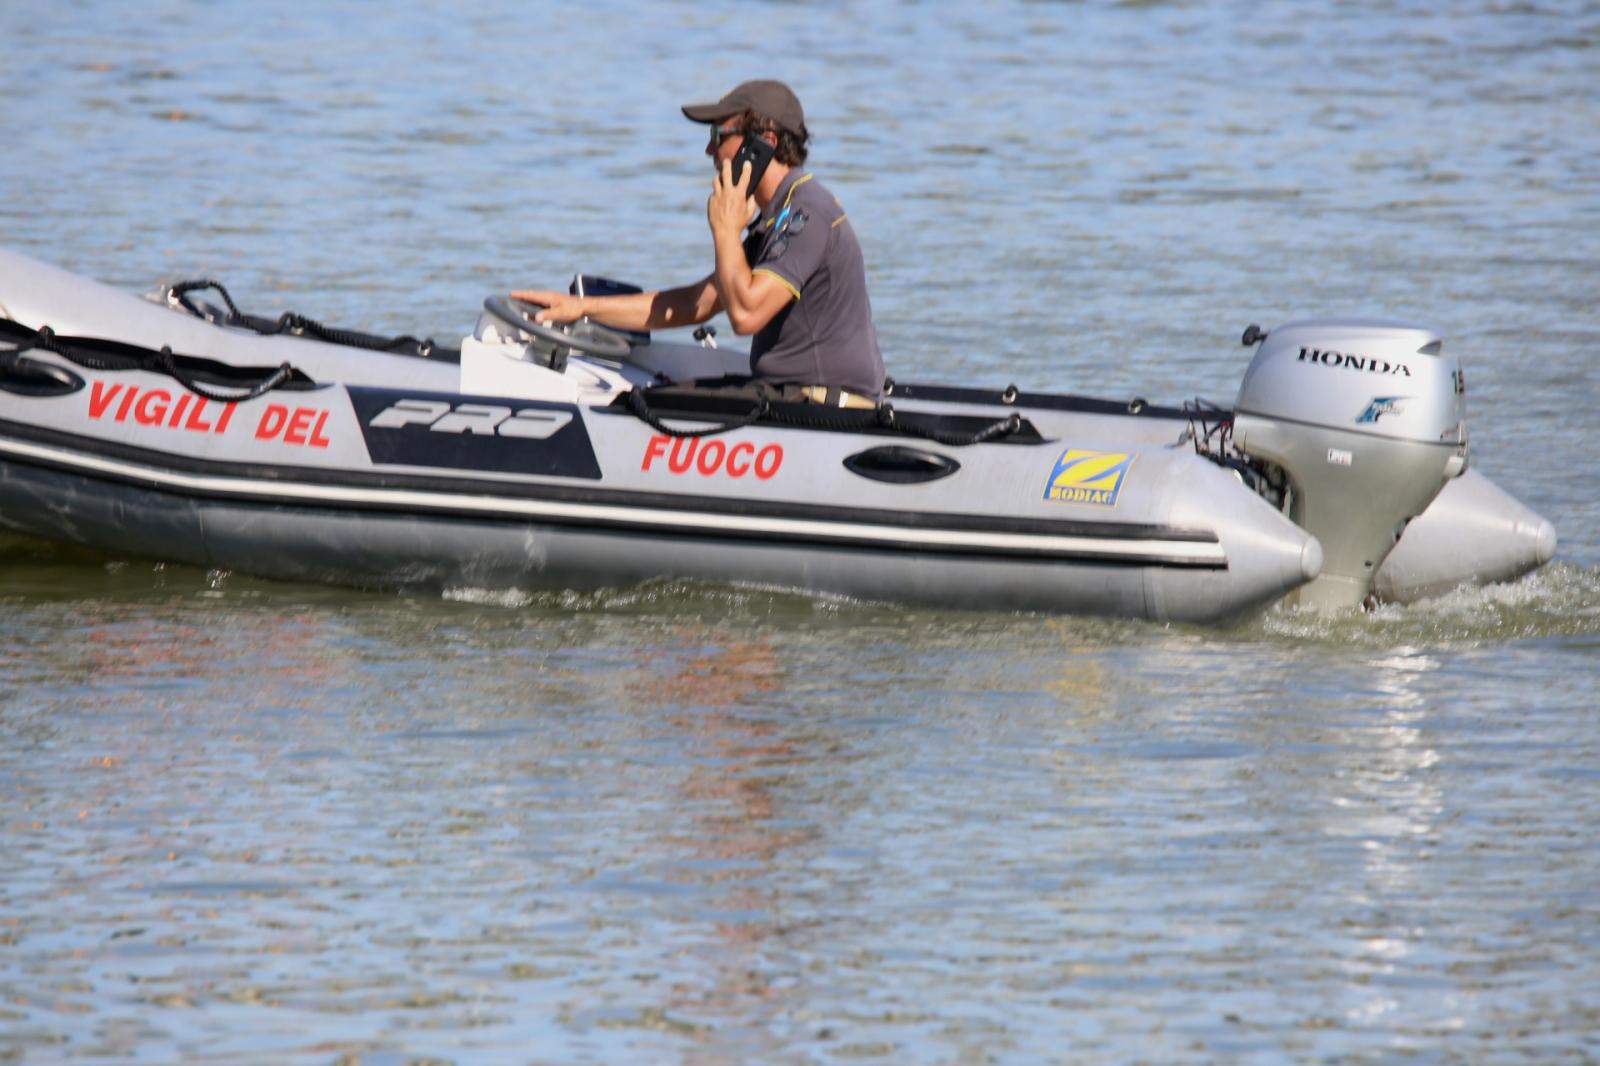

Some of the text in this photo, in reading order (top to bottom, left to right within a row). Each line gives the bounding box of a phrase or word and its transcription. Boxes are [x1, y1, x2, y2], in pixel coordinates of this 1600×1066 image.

[1297, 346, 1412, 377] HONDA
[88, 381, 785, 481] VIGILI DEL FUOCO
[369, 398, 573, 440] PRO
